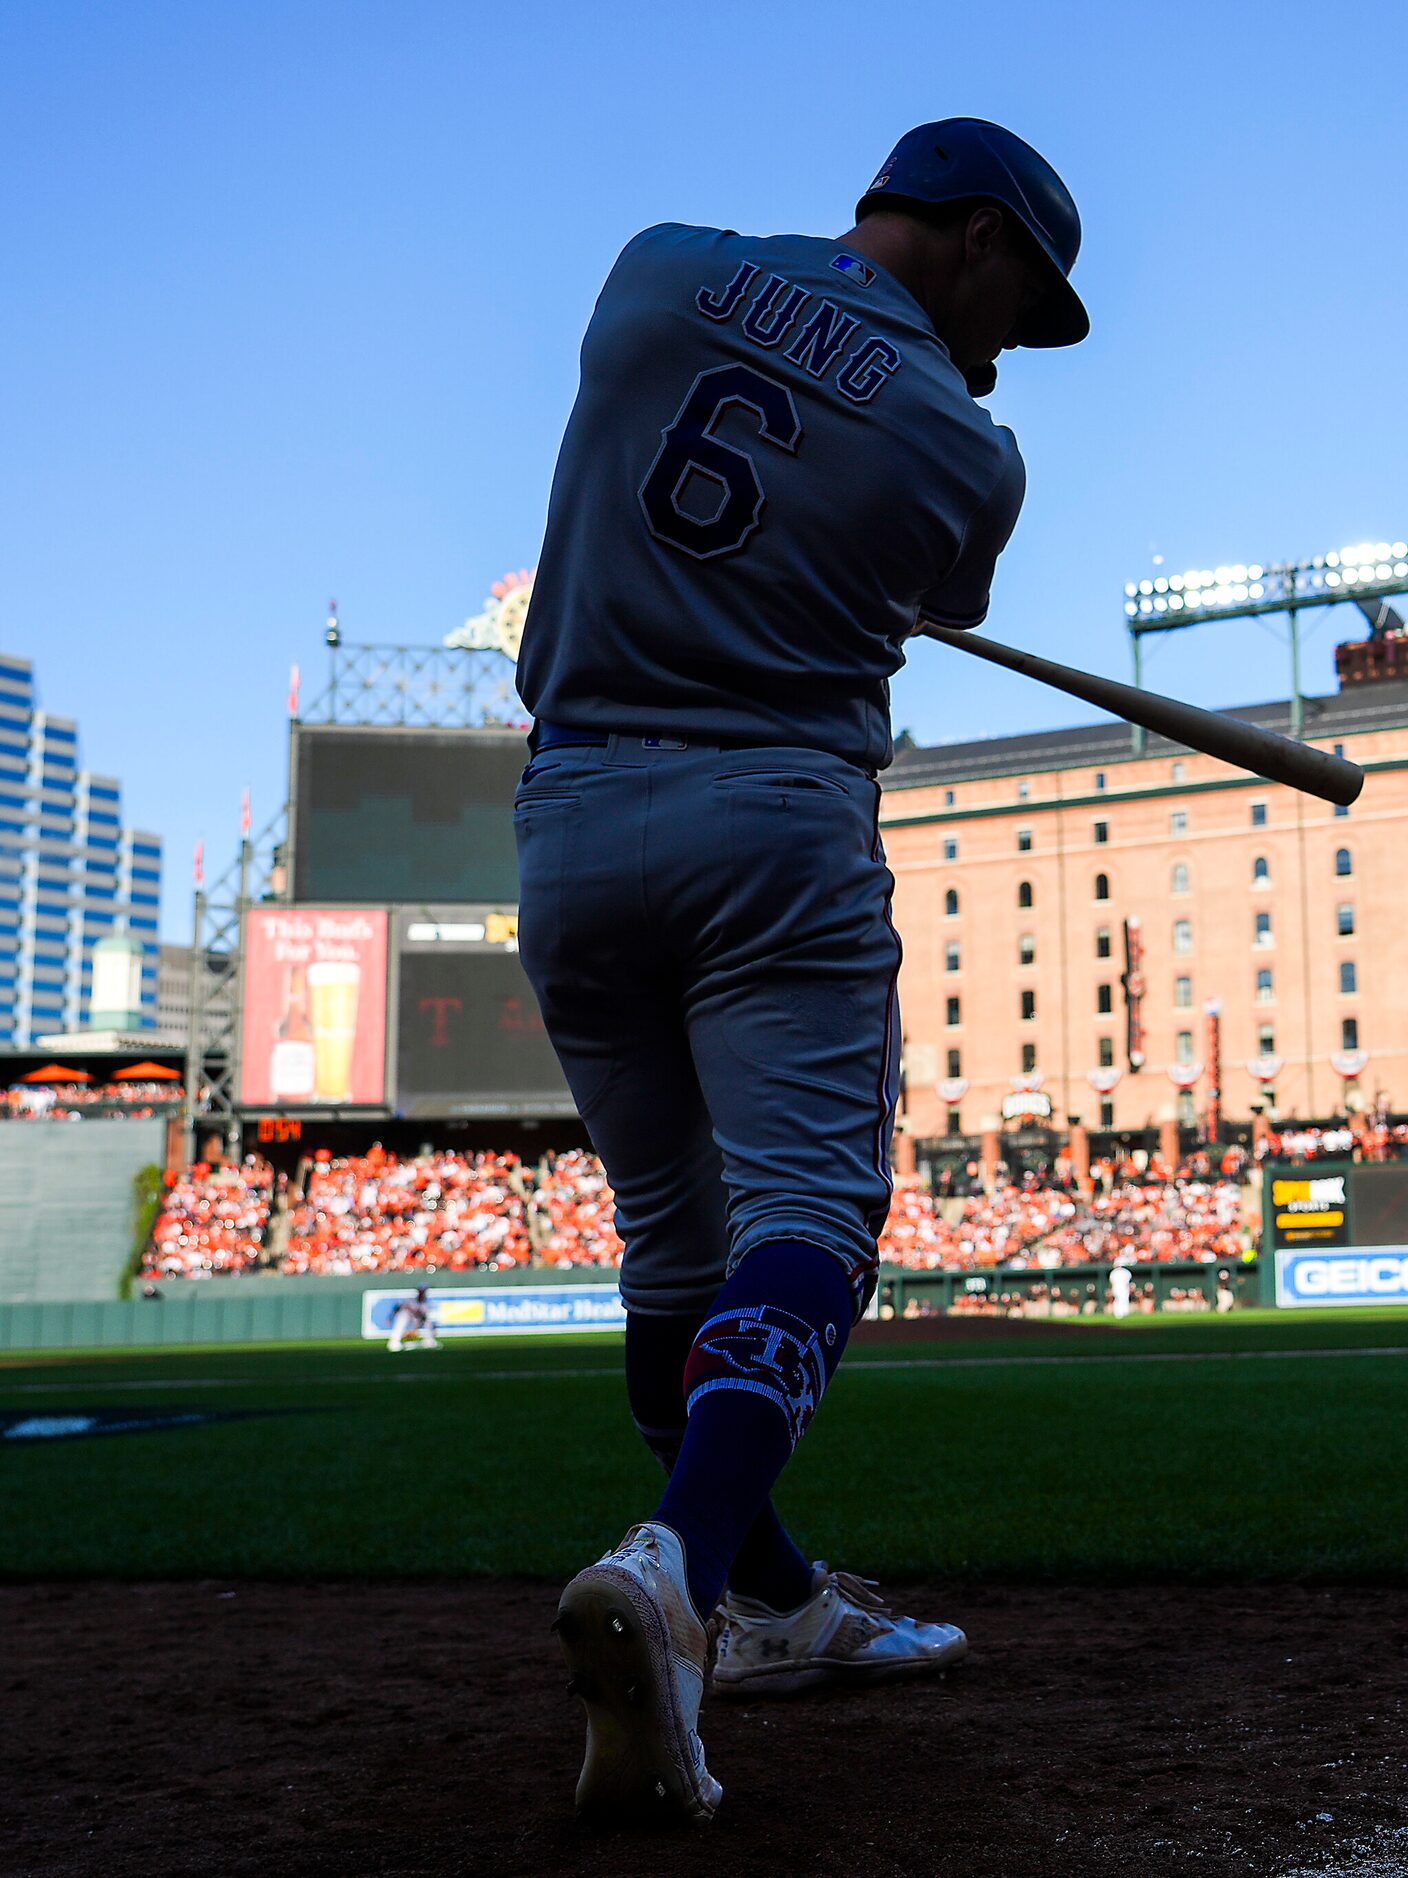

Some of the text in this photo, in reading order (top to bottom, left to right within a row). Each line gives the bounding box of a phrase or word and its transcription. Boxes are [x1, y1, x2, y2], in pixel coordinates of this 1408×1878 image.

[695, 260, 903, 405] JUNG
[637, 361, 805, 560] 6
[263, 916, 314, 940] This
[274, 939, 311, 961] For
[417, 997, 463, 1047] T
[486, 1299, 572, 1321] MedStar
